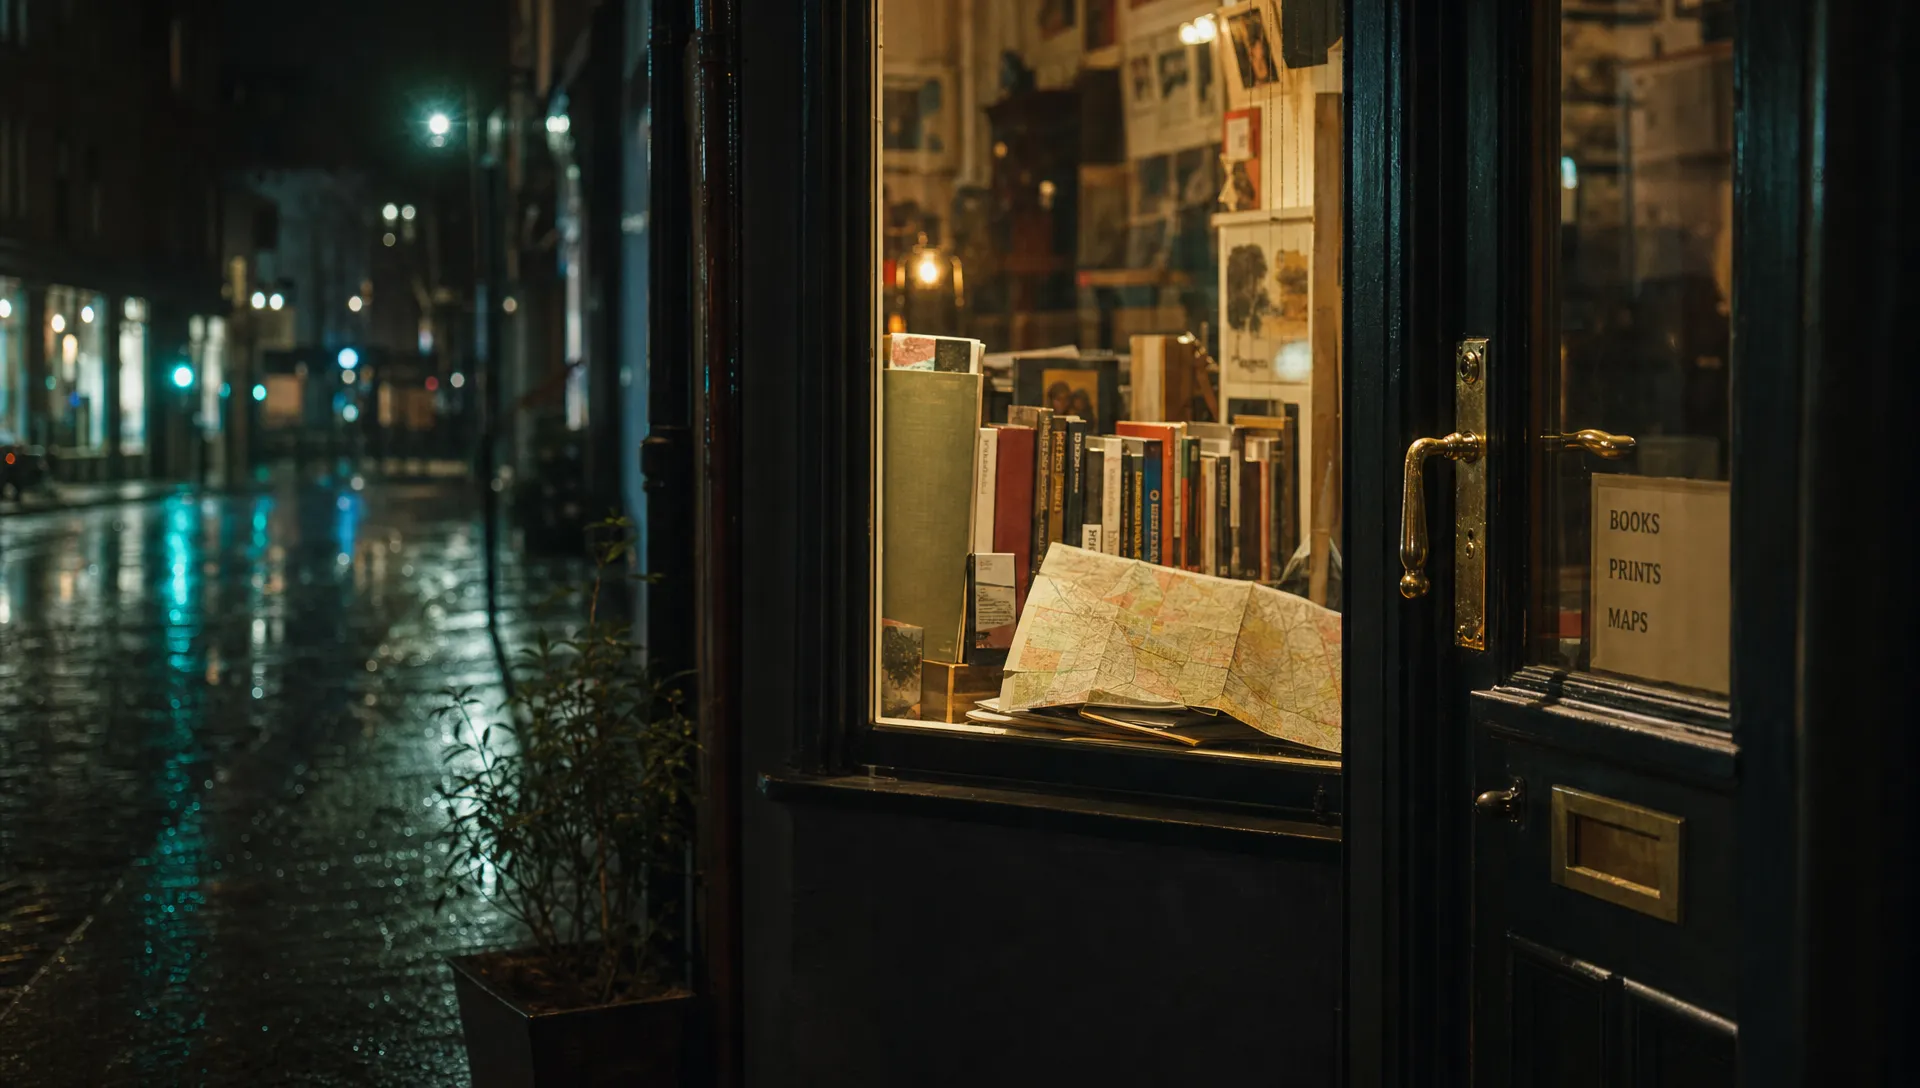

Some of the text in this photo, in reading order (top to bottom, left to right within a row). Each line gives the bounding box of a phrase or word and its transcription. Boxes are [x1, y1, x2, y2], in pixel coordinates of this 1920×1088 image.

[1609, 509, 1660, 534] BOOKS
[1608, 558, 1662, 585] PRINTS
[1607, 607, 1648, 633] MAPS
